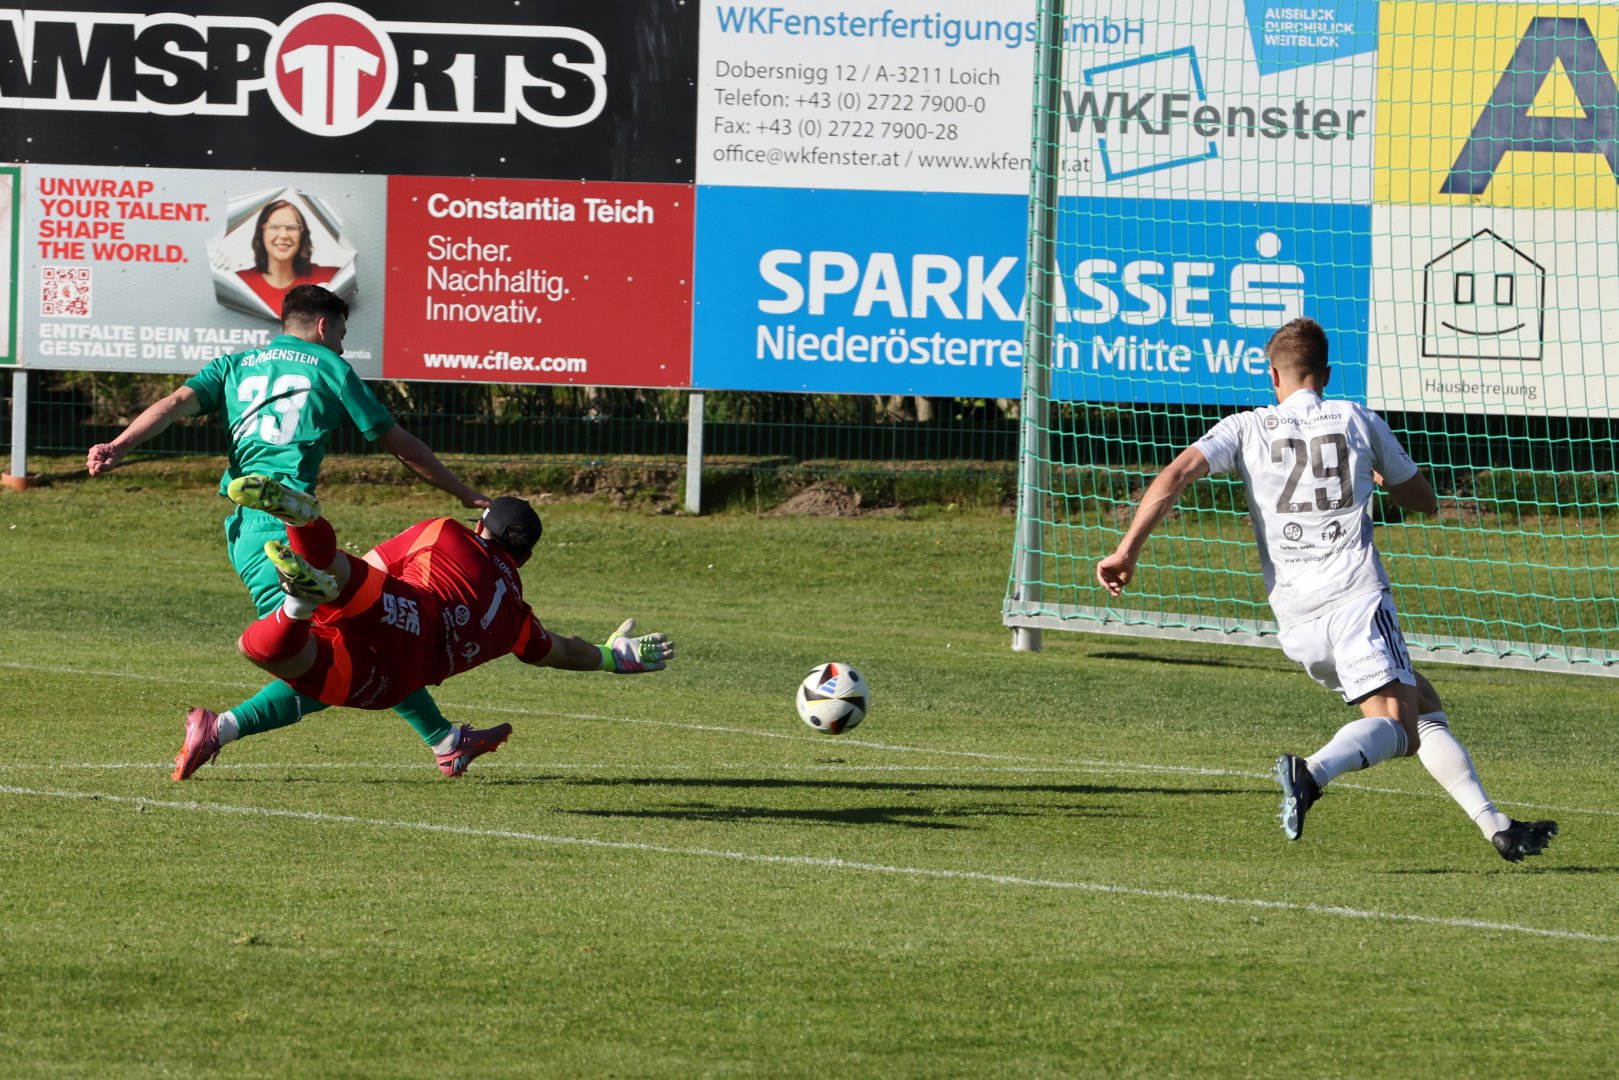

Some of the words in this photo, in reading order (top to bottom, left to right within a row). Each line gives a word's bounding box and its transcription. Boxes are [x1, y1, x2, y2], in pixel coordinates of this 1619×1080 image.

[1265, 8, 1335, 21] AUSBLICK
[1061, 16, 1145, 44] mbH
[1265, 21, 1354, 34] DURCHBLICK
[1264, 35, 1339, 47] WEITBLICK
[715, 60, 828, 84] Dobersnigg
[836, 64, 857, 82] 12
[862, 65, 871, 83] /
[875, 65, 942, 83] A-3211
[949, 67, 1001, 86] Loich
[714, 88, 790, 108] Telefon:
[795, 92, 832, 109] +43
[838, 92, 862, 112] (0)
[867, 93, 914, 111] 2722
[920, 95, 986, 113] 7900-0
[1062, 89, 1366, 142] WKFenster
[714, 116, 751, 135] Fax:
[756, 119, 792, 135] +43
[798, 119, 822, 139] (0)
[828, 120, 875, 138] 2722
[881, 122, 959, 141] 7900-28
[713, 145, 900, 167] office@wkfenster.at
[918, 152, 1091, 173] www.wkfenr.at
[39, 178, 154, 198] UNWRAP
[40, 199, 110, 218] YOUR
[116, 201, 210, 222] TALENT.
[427, 193, 576, 221] Constantia
[583, 198, 654, 224] Teich
[38, 220, 125, 240] SHAPE
[38, 241, 85, 260] THE
[92, 243, 188, 263] WORLD.
[427, 234, 512, 262] Sicher.
[427, 266, 570, 302] Nachhaltig.
[426, 296, 542, 324] Innovativ.
[39, 323, 134, 341] ENTFALTE
[139, 326, 188, 343] DEIN
[194, 327, 271, 346] TALENT.
[39, 340, 137, 358] GESTALTE
[142, 342, 176, 360] DIE
[423, 352, 587, 372] www.cflex.com
[757, 325, 1079, 370] Niederösterreh
[1092, 335, 1192, 373] Mitte
[1202, 339, 1270, 374] We
[1425, 378, 1537, 400] Hausbetreuung
[1271, 433, 1354, 513] 29
